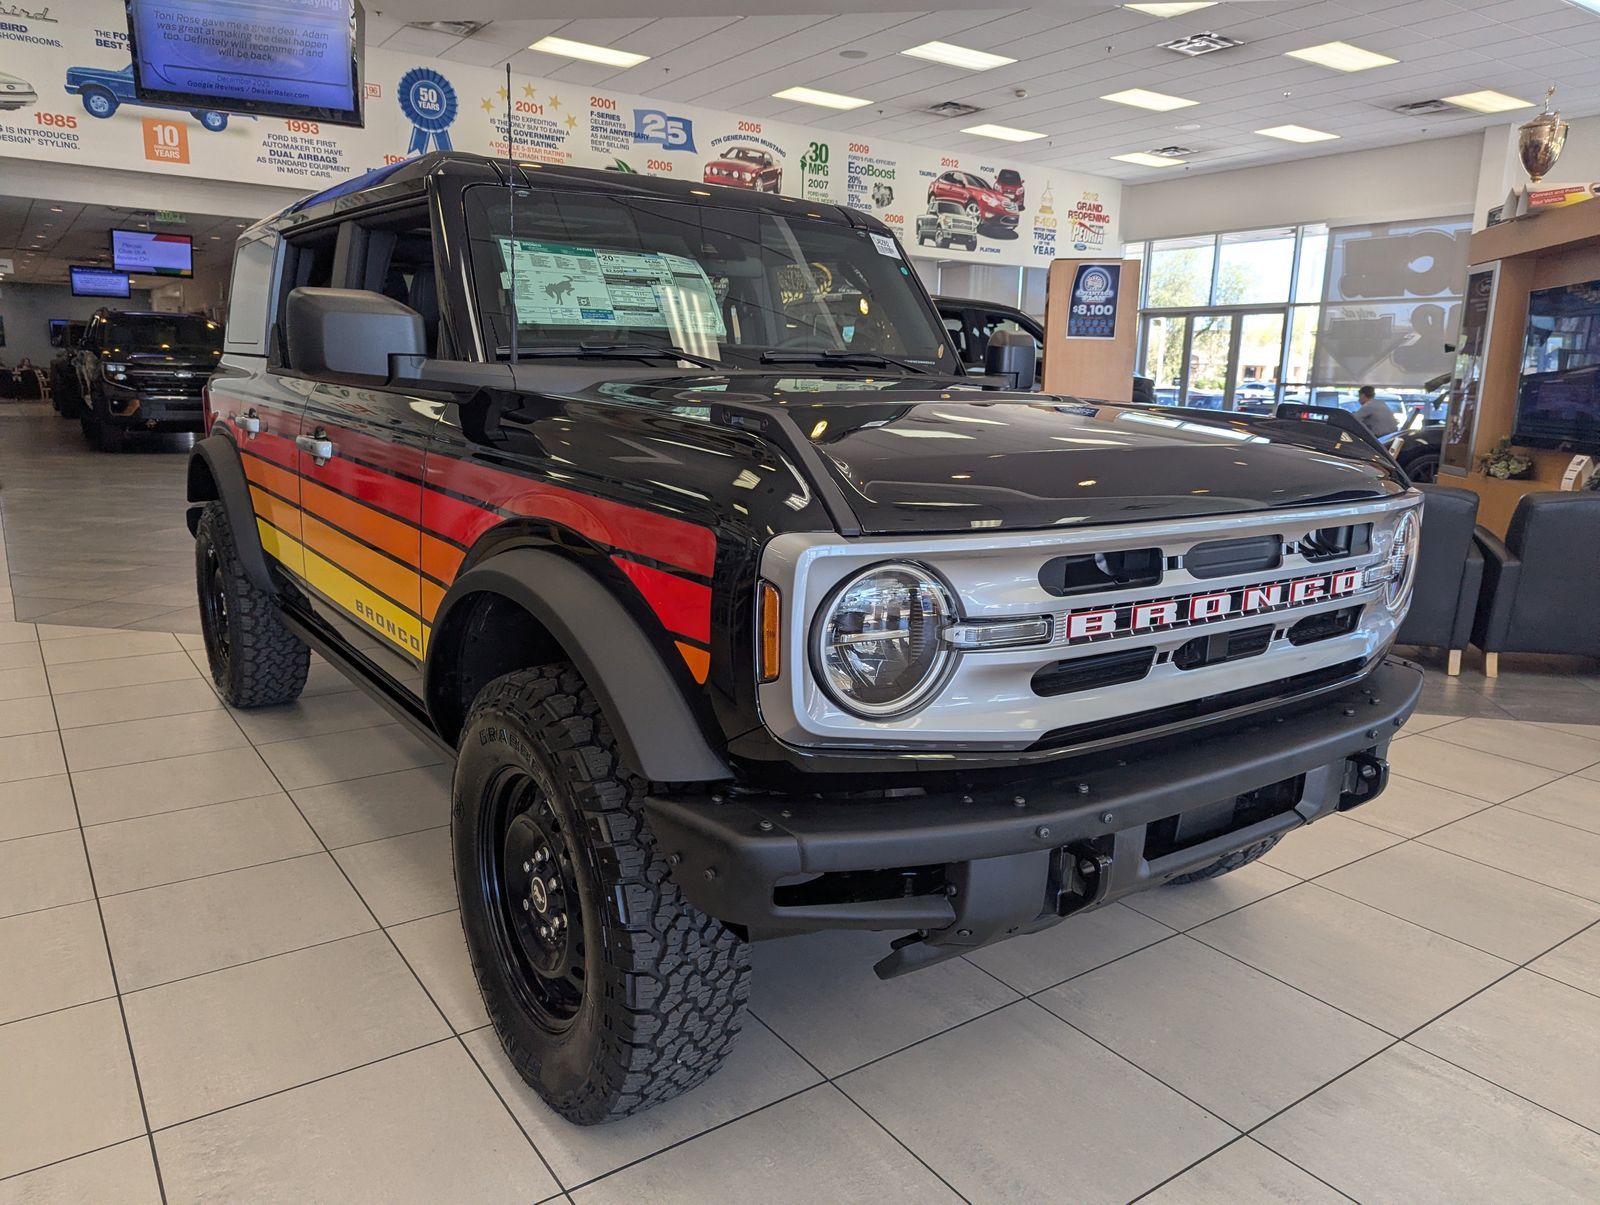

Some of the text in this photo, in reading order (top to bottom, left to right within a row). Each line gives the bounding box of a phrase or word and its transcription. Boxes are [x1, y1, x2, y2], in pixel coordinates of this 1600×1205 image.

[154, 9, 174, 20] Toni
[177, 13, 200, 24] Rose
[202, 17, 226, 27] gave
[227, 21, 242, 29] me
[251, 24, 275, 34] great
[302, 30, 329, 40] Adam
[94, 29, 131, 41] THE FO
[157, 22, 328, 49] was great at making the deal happen
[96, 39, 123, 49] BEST
[164, 32, 324, 58] too. Definitely will recommend and
[218, 48, 275, 61] will be back.
[187, 80, 213, 89] Google
[215, 83, 244, 93] Reviews
[251, 87, 310, 99] DealerRater.com
[419, 87, 438, 103] 50
[417, 101, 440, 111] YEARS
[515, 100, 544, 115] 2001
[590, 96, 616, 110] 2001
[34, 112, 78, 129] 1985
[503, 113, 558, 127] FRD EXPEDITION
[590, 110, 621, 121] F-SERIES
[285, 119, 320, 135] 1993
[590, 118, 627, 129] CELEBRATES
[642, 113, 687, 145] 25
[738, 121, 761, 133] 2005
[6, 126, 15, 134] IS
[17, 127, 79, 141] INTRODUCED
[153, 124, 179, 146] 10
[513, 130, 565, 143] GOVERNMENT
[590, 125, 649, 140] 25TH ANIVERSARY
[599, 133, 630, 144] AMERICA'S
[38, 138, 80, 150] STYLING.
[268, 133, 289, 142] FORD
[299, 137, 315, 145] THE
[316, 139, 337, 148] FIRST
[530, 139, 560, 150] RATING.
[606, 141, 630, 151] SELLING
[711, 134, 787, 158] 5TH GENERATION MUSTANG
[154, 149, 181, 159] YEARS
[262, 140, 311, 152] AUTOMAKER
[324, 148, 343, 157] HAVE
[495, 142, 521, 151] DOULE
[543, 149, 565, 158] RATING
[809, 141, 829, 164] 30
[848, 142, 870, 154] 2009
[269, 149, 338, 164] DUAL AIRBAGS
[519, 151, 540, 160] CRASH
[268, 158, 308, 169] STANDARD
[309, 163, 350, 173] EQUIPMENT
[647, 159, 673, 172] 2005
[808, 162, 829, 176] MPG
[941, 157, 959, 168] 2012
[980, 165, 994, 173] FOCUS
[310, 170, 333, 178] CARS.
[848, 161, 895, 180] EcoBoost
[919, 169, 937, 178] TAURUS
[808, 178, 829, 190] 2007
[847, 175, 862, 185] 20%
[847, 183, 868, 191] BETTER
[848, 193, 861, 203] 15%
[847, 201, 872, 210] REDUCED
[1076, 201, 1103, 213] GRAND
[884, 213, 904, 224] 2008
[1034, 215, 1057, 229] F-150
[1067, 210, 1110, 224] REOPENING
[1033, 231, 1056, 242] TRUCK
[980, 246, 1001, 254] PLATINUM
[1033, 245, 1056, 256] YEAR
[602, 254, 614, 262] 20
[1072, 304, 1113, 316] $8,100
[1066, 568, 1363, 640] BRONCO
[355, 599, 421, 652] BRONCO
